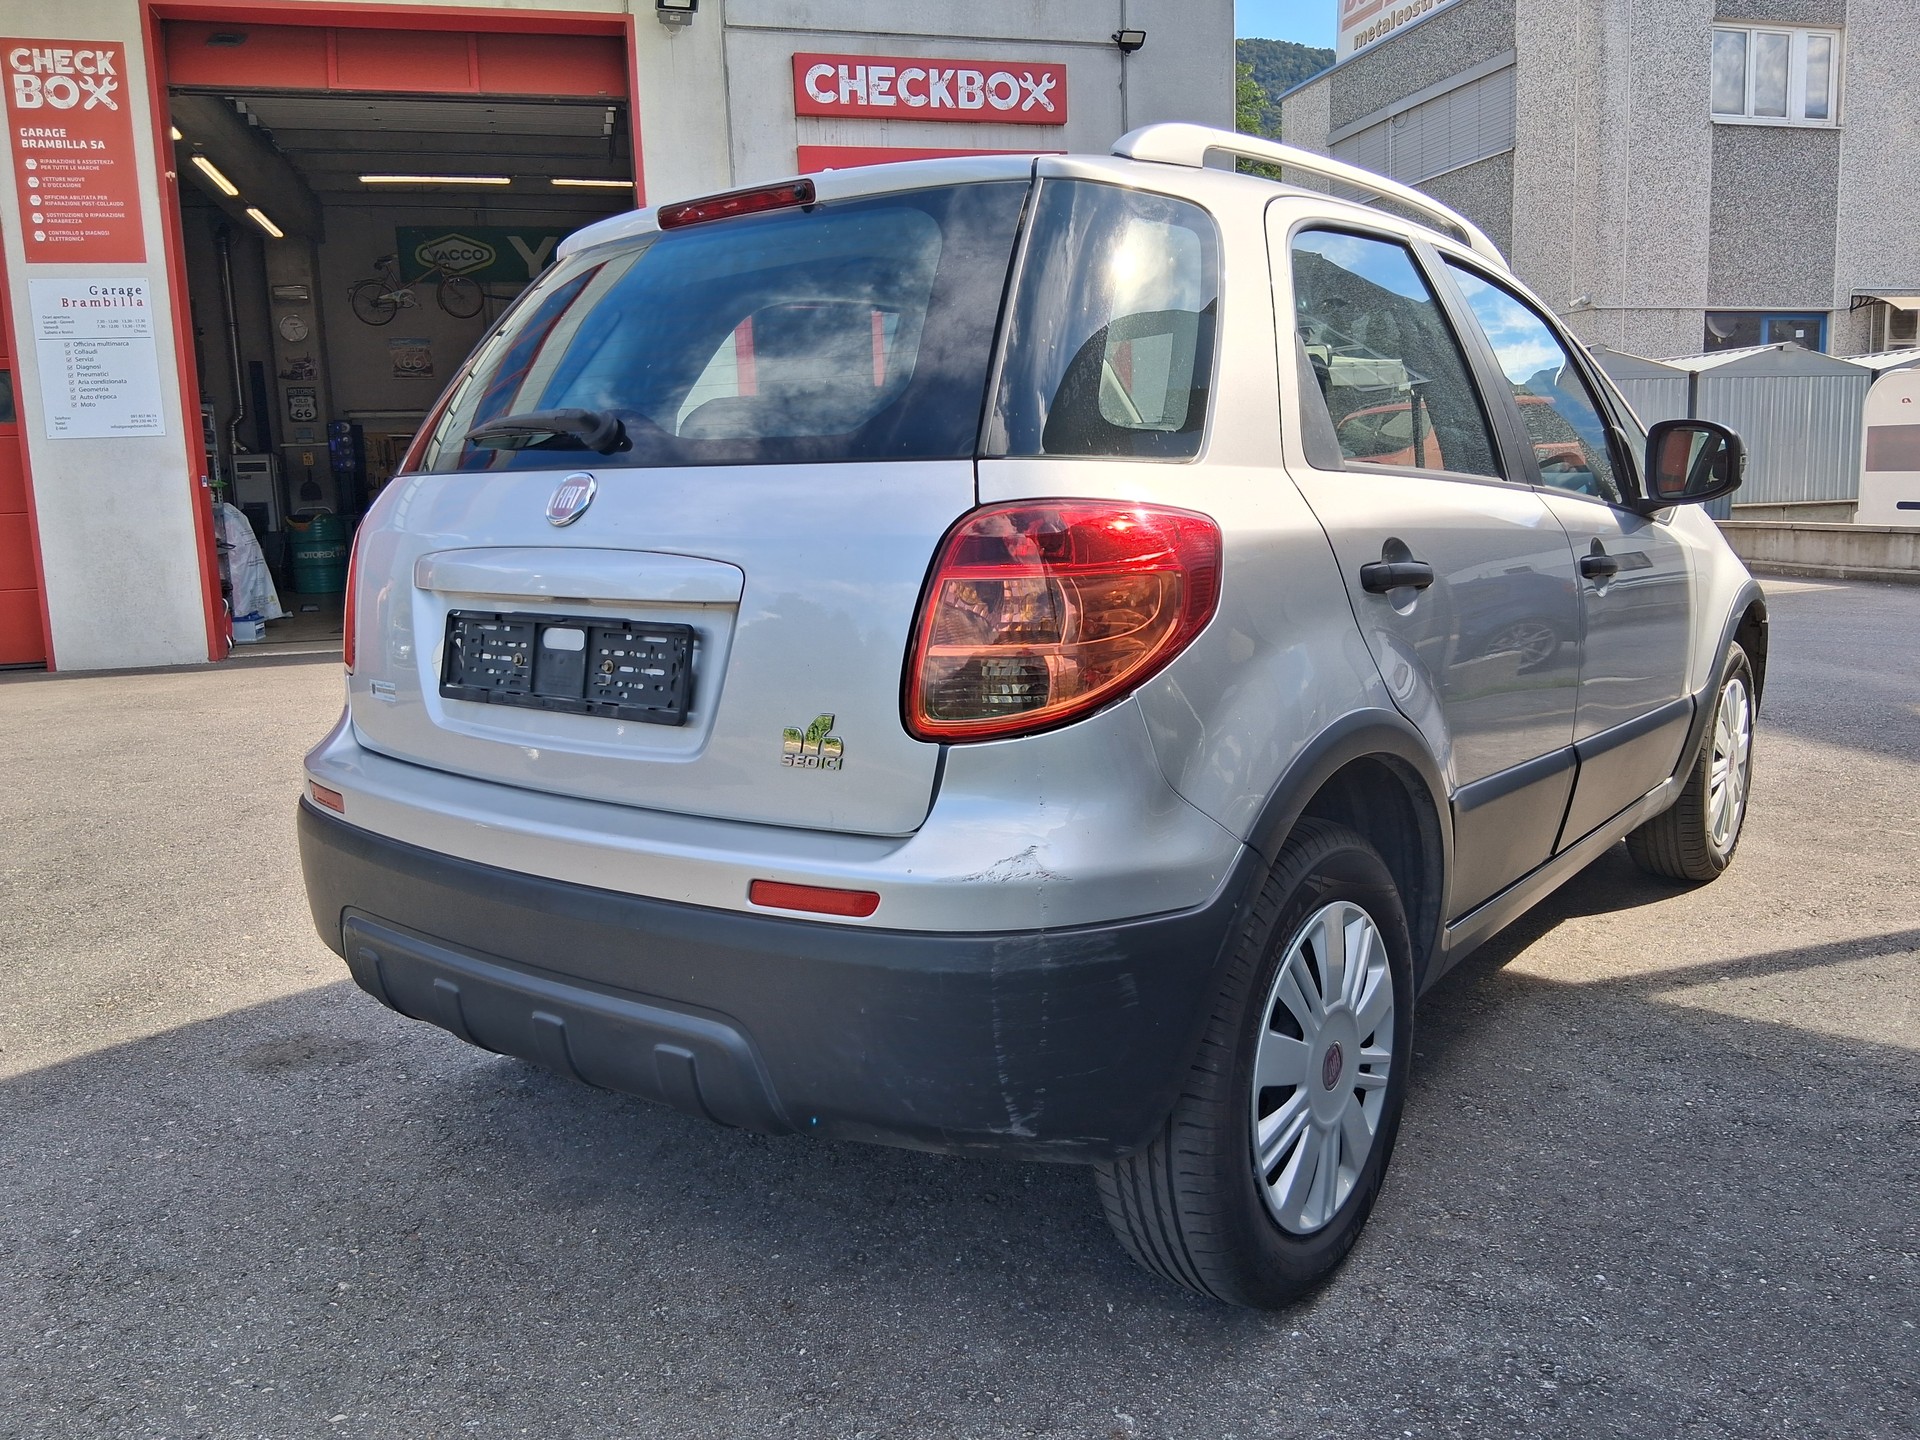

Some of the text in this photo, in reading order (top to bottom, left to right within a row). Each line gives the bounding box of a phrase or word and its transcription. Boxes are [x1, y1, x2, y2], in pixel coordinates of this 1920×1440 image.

[1353, 0, 1445, 50] metalcostr
[10, 48, 117, 75] CHECK
[13, 74, 118, 110] BOX
[805, 63, 1056, 112] CHECKBOX
[20, 128, 67, 137] GARAGE
[22, 139, 105, 149] BRAMBILLA SA
[434, 250, 484, 261] YACCO
[89, 285, 142, 297] Garage
[61, 296, 144, 308] Brambilla
[402, 355, 422, 368] 66
[295, 408, 312, 418] 66
[553, 485, 585, 509] FIAT
[297, 550, 336, 559] MOTOREX
[781, 754, 844, 770] SEDICI
